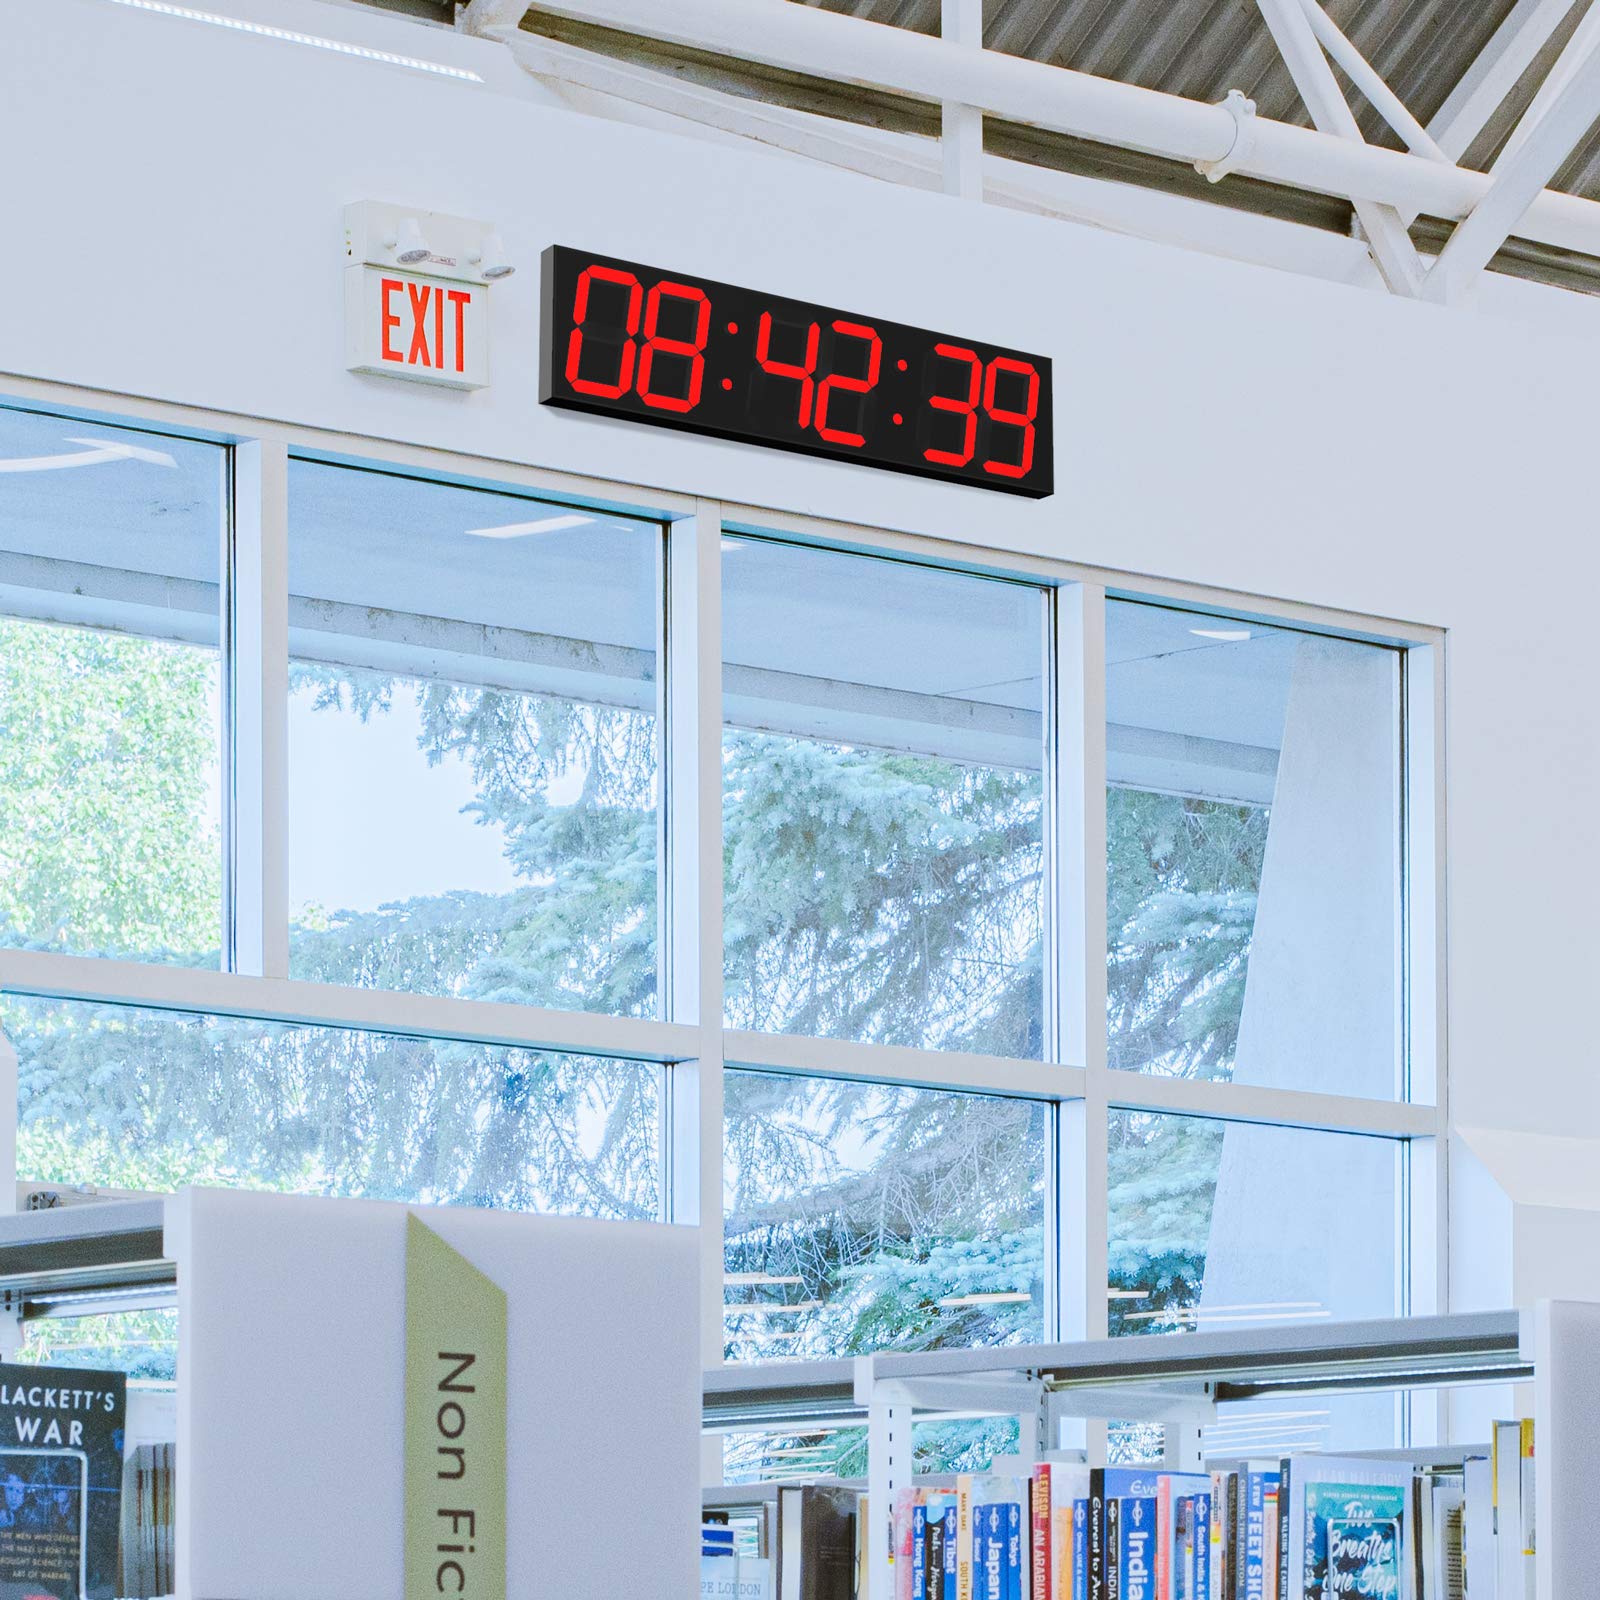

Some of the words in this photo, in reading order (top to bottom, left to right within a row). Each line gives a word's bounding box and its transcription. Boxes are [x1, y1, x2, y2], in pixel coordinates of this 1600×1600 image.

[381, 277, 472, 374] EXIT
[14, 1416, 84, 1446] WAR
[437, 1352, 476, 1480] Non
[1039, 1473, 1049, 1519] LEVISON
[1252, 1475, 1260, 1484] A
[1252, 1485, 1261, 1507] FEW
[1092, 1496, 1101, 1552] Everest
[1344, 1501, 1374, 1529] Two
[1009, 1535, 1019, 1568] Tokyo
[1034, 1529, 1045, 1547] AN
[1197, 1526, 1206, 1555] South
[1248, 1511, 1262, 1559] FEET
[436, 1508, 476, 1600] Fic
[914, 1538, 924, 1568] Hong
[946, 1538, 956, 1574] Tibet
[985, 1537, 1003, 1600] Japan
[1092, 1557, 1100, 1572] to
[1128, 1531, 1149, 1600] India
[1197, 1557, 1206, 1582] India
[914, 1570, 924, 1598] Kong
[960, 1561, 969, 1589] SOUTH
[1034, 1549, 1046, 1600] ARABIAN
[1108, 1565, 1117, 1600] INDIA
